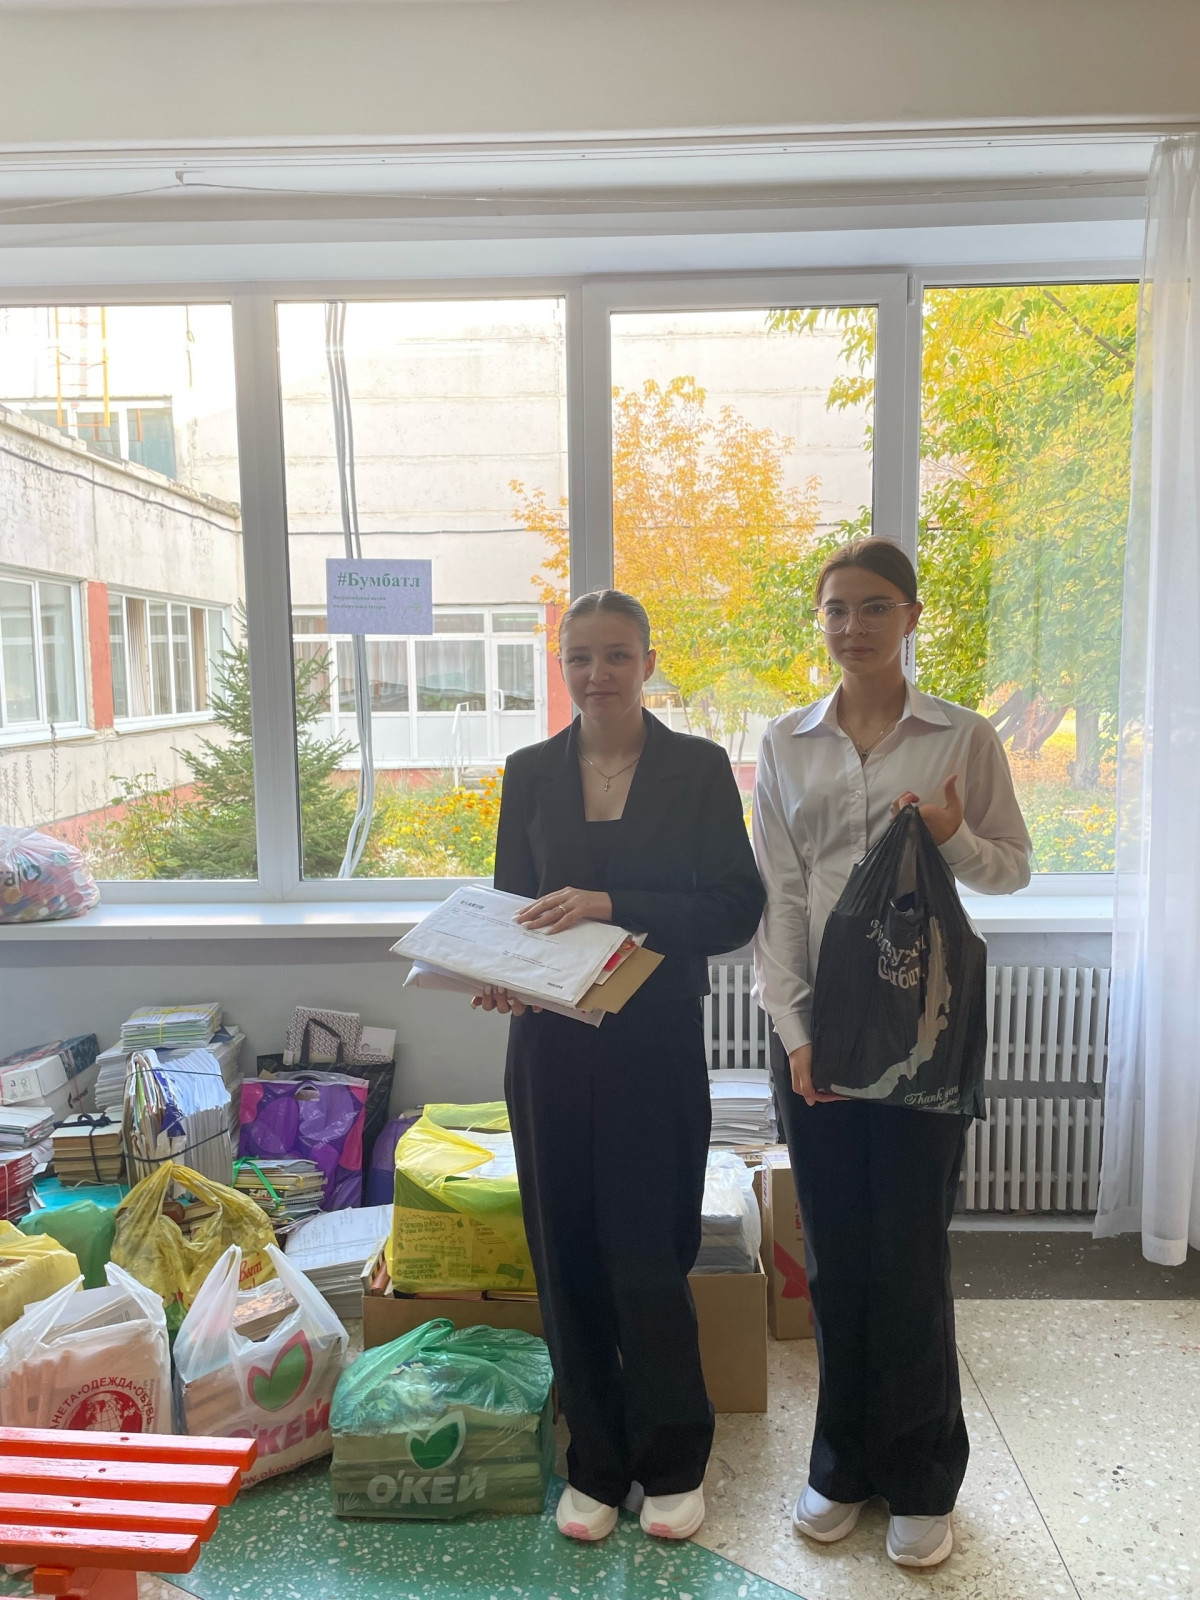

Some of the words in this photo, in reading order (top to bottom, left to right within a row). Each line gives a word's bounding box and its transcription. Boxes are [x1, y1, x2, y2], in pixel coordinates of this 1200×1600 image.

[337, 571, 421, 590] #Бумбатл
[904, 1087, 944, 1105] Thank
[81, 1376, 133, 1394] ОДЕЖДА
[135, 1386, 154, 1425] ОБУВЬ
[229, 1398, 331, 1457] 'КЕЙ
